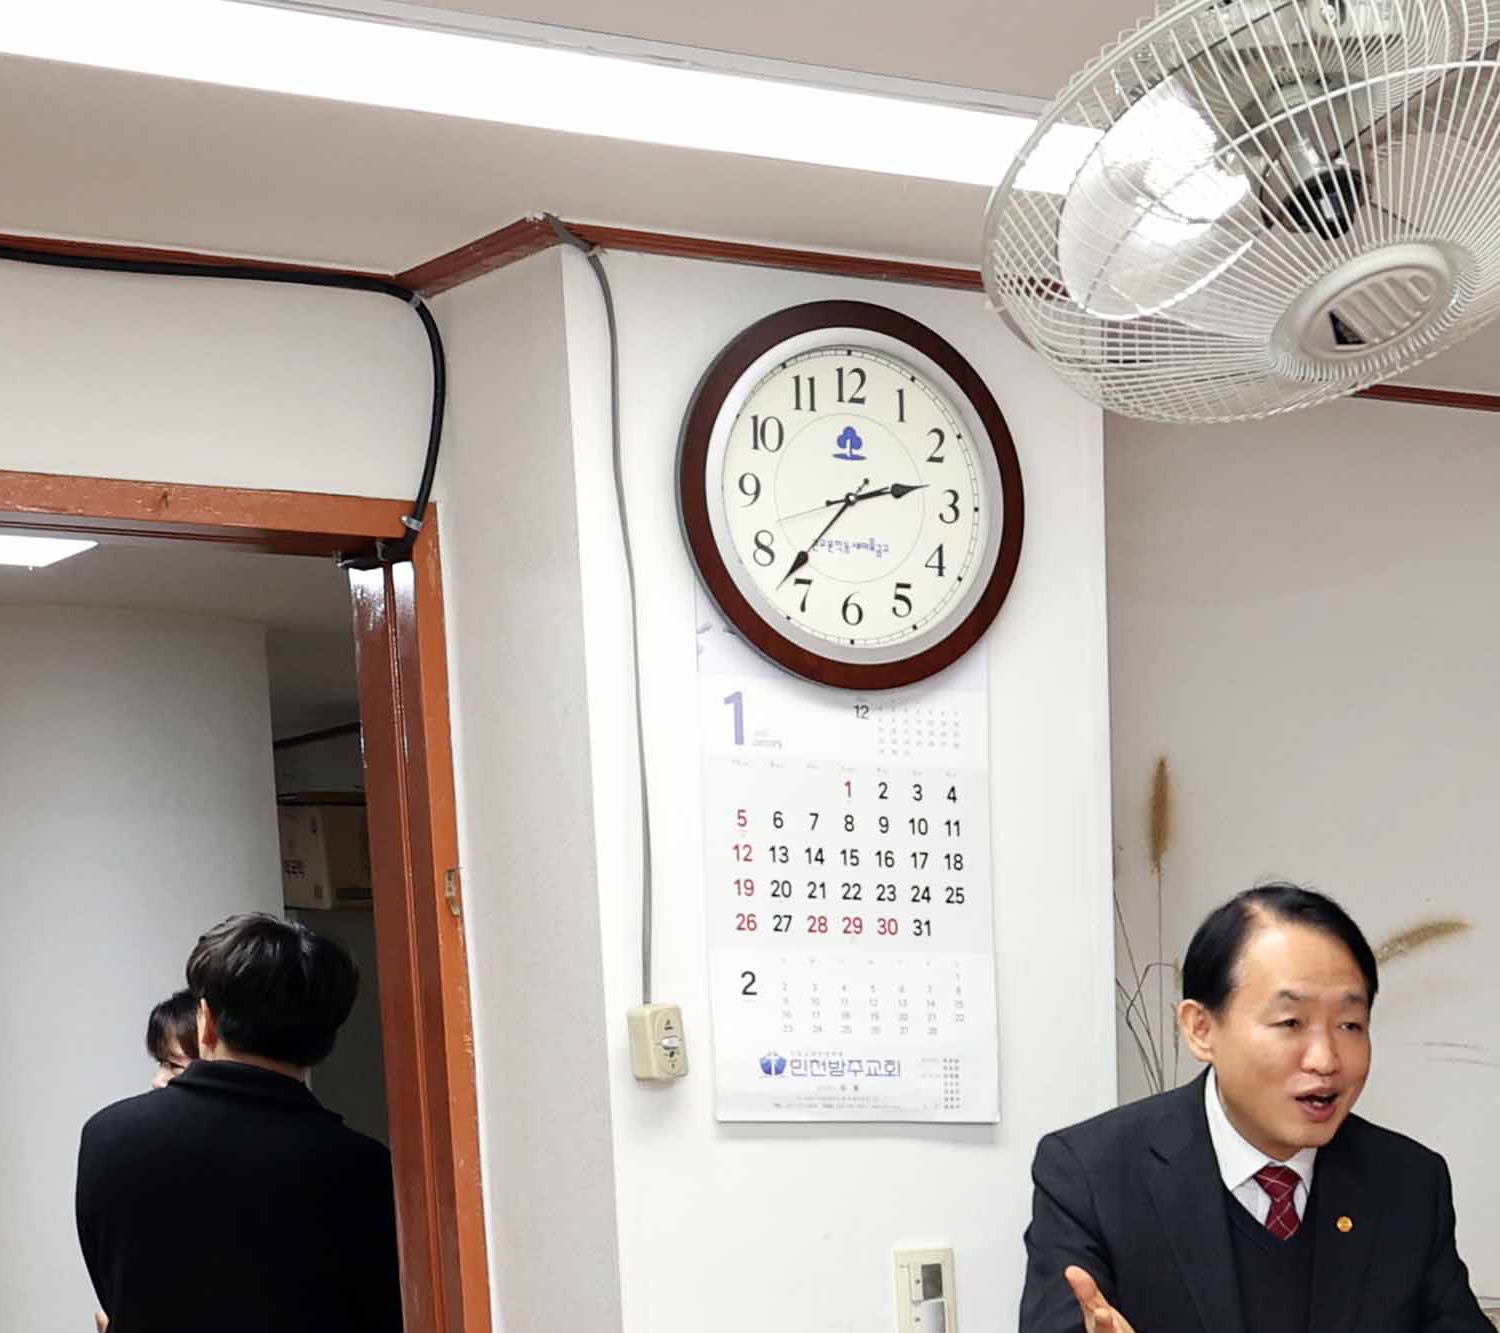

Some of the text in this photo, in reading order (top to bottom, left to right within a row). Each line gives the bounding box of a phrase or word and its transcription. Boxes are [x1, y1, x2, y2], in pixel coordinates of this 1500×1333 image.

[793, 375, 817, 412] 11
[836, 367, 867, 404] 12
[896, 389, 905, 422] 1
[750, 415, 784, 452] 10
[926, 428, 946, 463] 2
[738, 473, 761, 507] 9
[938, 489, 960, 524] 3
[752, 530, 775, 566] 8
[925, 543, 946, 577] 4
[793, 578, 813, 613] 7
[841, 591, 864, 626] 6
[891, 582, 913, 618] 5
[723, 691, 745, 746] 1
[853, 704, 870, 721] 12
[844, 780, 957, 803] 1 2 3 4
[737, 808, 961, 837] 5 6 7 8 9 10 11
[732, 843, 964, 872] 12 13 14 15 16 17 18
[733, 878, 965, 905] 19 20 21 22 23 24 25
[735, 912, 931, 937] 26 27 28 29 30 31
[740, 971, 758, 996] 2
